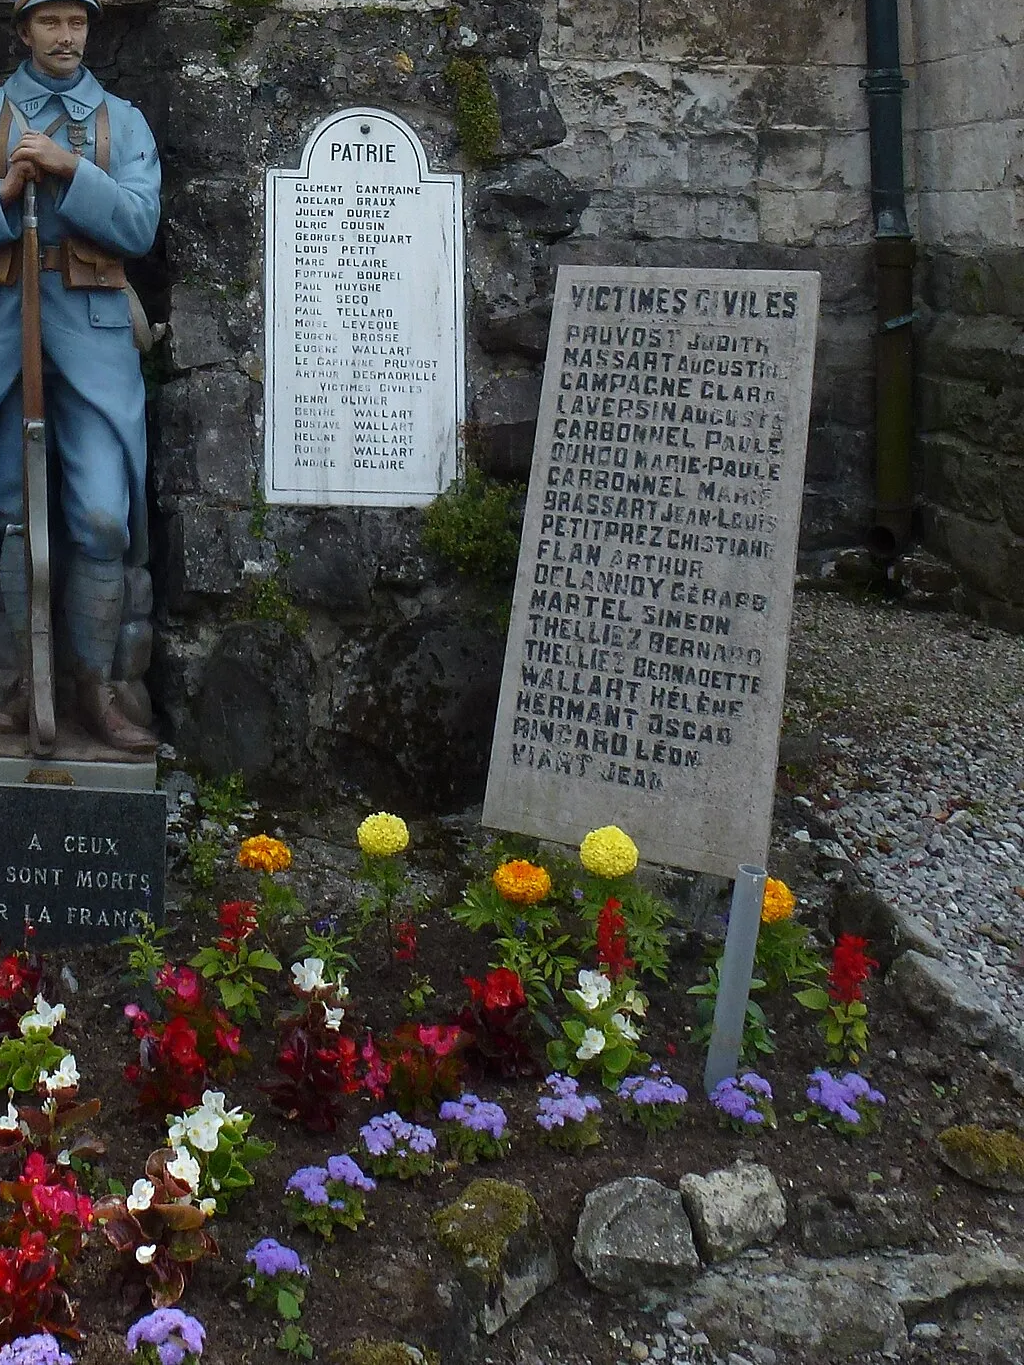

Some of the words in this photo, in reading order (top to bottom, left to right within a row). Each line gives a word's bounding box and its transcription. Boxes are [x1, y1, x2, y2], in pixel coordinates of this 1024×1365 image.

[331, 143, 396, 163] PATRIE
[295, 183, 343, 193] CLEMENT
[356, 185, 421, 196] CANTRAINE
[295, 196, 344, 205] ADELARD
[356, 198, 396, 207] GRAUX
[295, 207, 334, 217] JULIEN
[347, 209, 390, 219] DURIEZ
[295, 220, 327, 230] ULRIC
[341, 221, 385, 231] COUSIN
[295, 232, 345, 242] GEORGES
[357, 234, 413, 244] BEQUART
[295, 244, 328, 254] LOUIS
[341, 246, 377, 255] PETIT
[295, 257, 324, 266] MARC
[337, 258, 388, 268] DELAIRE
[357, 271, 403, 280] BOUREL
[294, 282, 322, 291] PAUL
[335, 283, 382, 292] HUYGHE
[294, 293, 322, 303] PAUL
[336, 294, 369, 306] SECQ
[571, 284, 688, 315] VICTIMES
[695, 289, 798, 319] CIVILES
[294, 306, 322, 316] PAUL
[336, 307, 393, 318] TELLARD
[342, 320, 400, 331] LEVEQUE
[352, 333, 399, 342] BROSSE
[351, 345, 412, 356] WALLART
[384, 358, 438, 368] PRUVOST
[563, 347, 675, 372] MASSART
[320, 382, 370, 392] VICTIMES
[559, 371, 693, 396] CAMPAGNE
[294, 394, 328, 404] HENRI
[341, 396, 388, 406] OLIVIER
[353, 409, 414, 419] WALLART
[555, 394, 677, 422] LAVERSIN
[554, 418, 696, 449] CARBONNEL
[353, 446, 414, 458] WALLART
[546, 466, 684, 498] CARBONNEL
[543, 490, 659, 520] BRASSART
[540, 514, 666, 547] PETITPREZ
[537, 539, 601, 567] FLAN
[610, 549, 704, 579] ARTHUR
[529, 589, 633, 622] MARTEL
[642, 604, 731, 635] SIMEON
[633, 655, 762, 694] BERNADETTE
[522, 664, 641, 703] WALLART
[651, 685, 743, 718] HÉLÈNE
[517, 690, 638, 730] HERMANT
[27, 833, 42, 851] A
[64, 836, 120, 855] CEUX
[6, 866, 63, 885] SONT
[76, 870, 152, 891] MORTS
[24, 904, 52, 923] LA
[67, 907, 153, 928] FRANC
